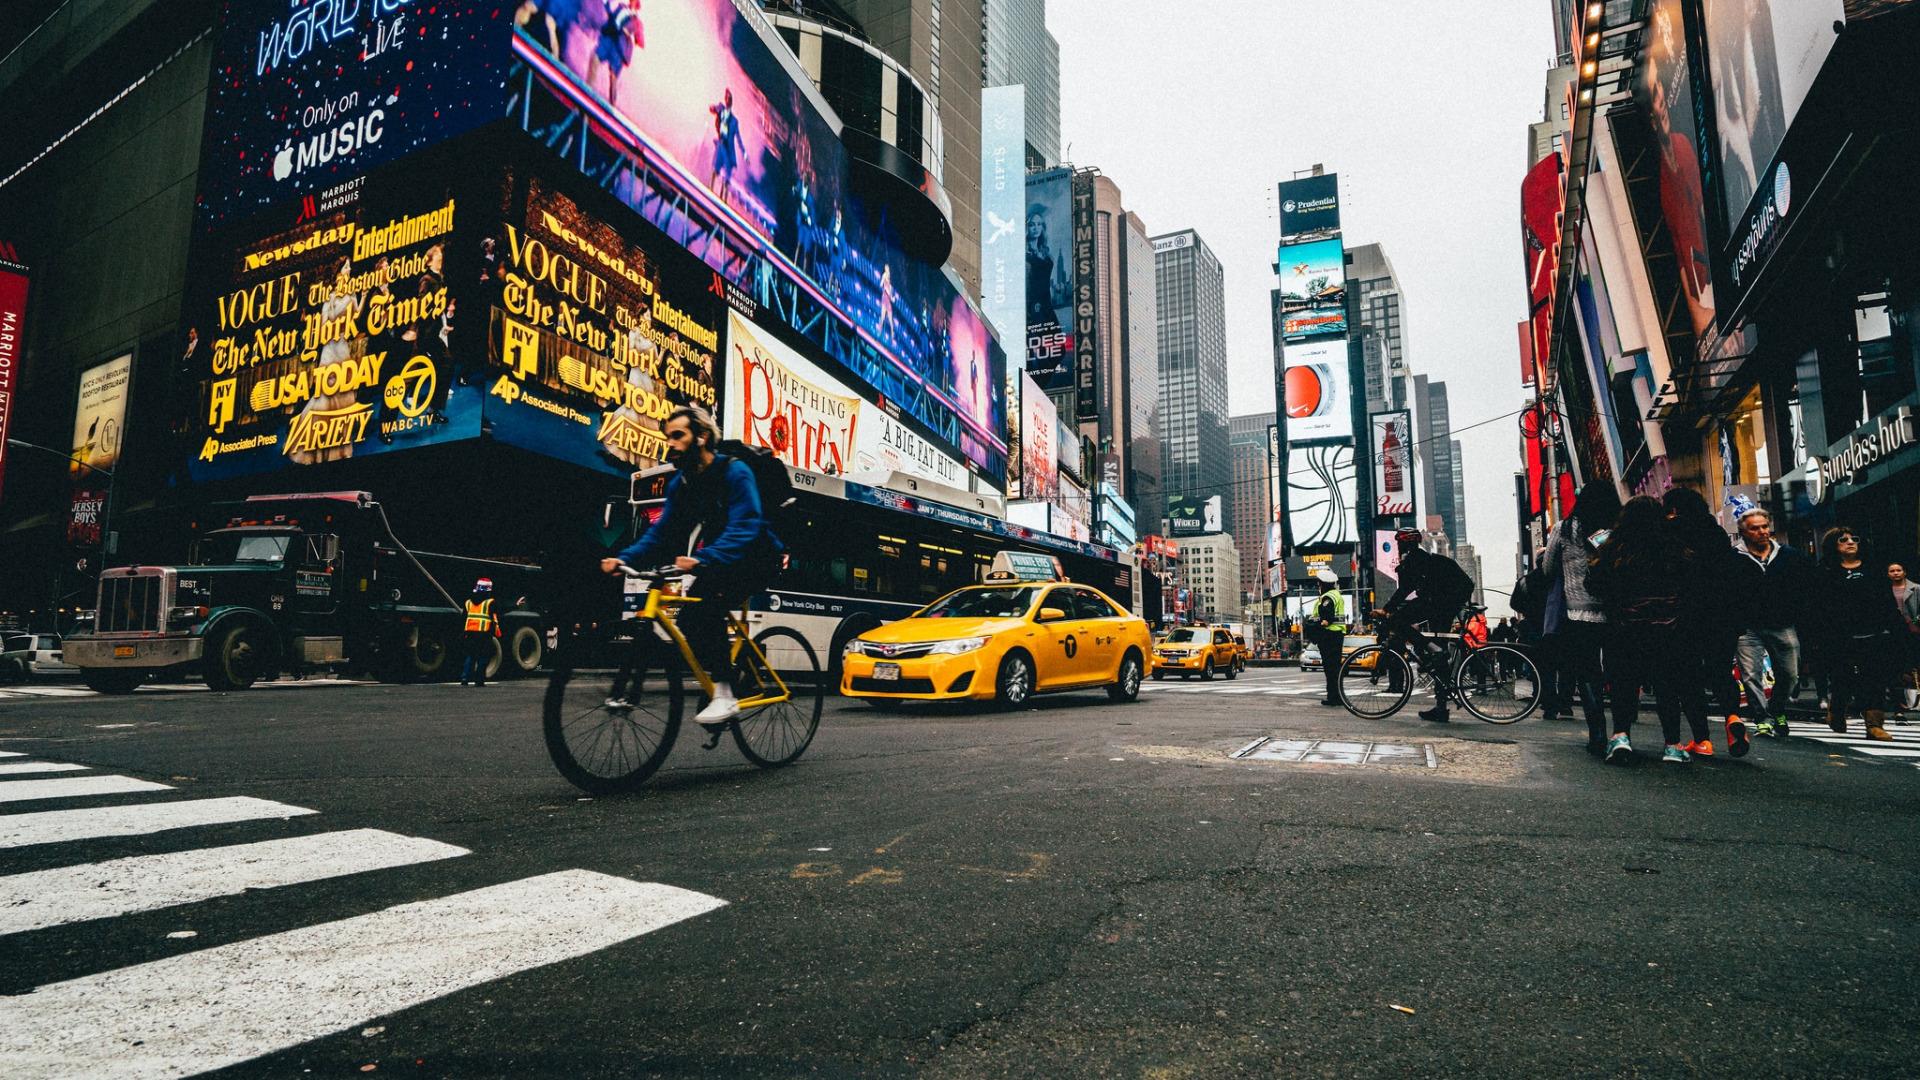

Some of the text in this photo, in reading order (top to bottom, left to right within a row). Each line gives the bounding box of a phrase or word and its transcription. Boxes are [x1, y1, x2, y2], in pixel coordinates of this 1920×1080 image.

[362, 13, 405, 62] LIVE
[303, 92, 358, 128] Only on
[296, 110, 384, 174] MUSIC
[320, 191, 359, 212] MARQUIS
[321, 177, 366, 198] MARRIOTT
[1298, 196, 1335, 208] Prudential
[353, 200, 455, 262] Entertainment
[243, 222, 355, 272] Newsday
[540, 210, 653, 295] Newsday
[308, 251, 429, 306] The Boston Globe
[505, 223, 607, 316] VOGUE
[218, 272, 301, 331] VOGUE
[727, 284, 758, 310] MARRIOTT
[727, 292, 754, 318] MARQUIS
[1076, 194, 1094, 388] TIMES SQUARE
[212, 286, 448, 375] The New York Times
[615, 305, 637, 330] The
[639, 317, 677, 353] Boston
[653, 291, 718, 353] Entertainment
[0, 311, 17, 388] MARRIOTT
[503, 272, 716, 406] The New York Times
[511, 328, 534, 347] NY
[1028, 332, 1067, 349] DES
[1027, 345, 1062, 361] LUE
[216, 382, 232, 399] NY
[271, 351, 387, 408] USA TODAY
[385, 385, 405, 398] abc
[491, 375, 519, 404] AP
[583, 361, 620, 405] USA
[754, 346, 846, 420] SOMETHING
[521, 391, 591, 426] Associated Press
[283, 403, 374, 456] VARIETY
[382, 415, 434, 434] WABC-TV
[596, 411, 672, 464] VARIETY
[199, 436, 218, 461] AP
[220, 434, 277, 454] Associated Press
[918, 440, 935, 469] FAT
[1823, 406, 1914, 486] sunglass hut
[794, 473, 817, 487] 6767
[72, 501, 103, 513] JERSEY
[74, 511, 97, 524] BOYS
[917, 504, 930, 514] JAN
[937, 508, 970, 524] THURSDAYS
[1173, 518, 1200, 528] WICKED
[1310, 553, 1333, 562] SUPPORT
[179, 580, 197, 588] BEST
[794, 600, 804, 608] York
[806, 601, 816, 610] City
[816, 602, 825, 610] Bus
